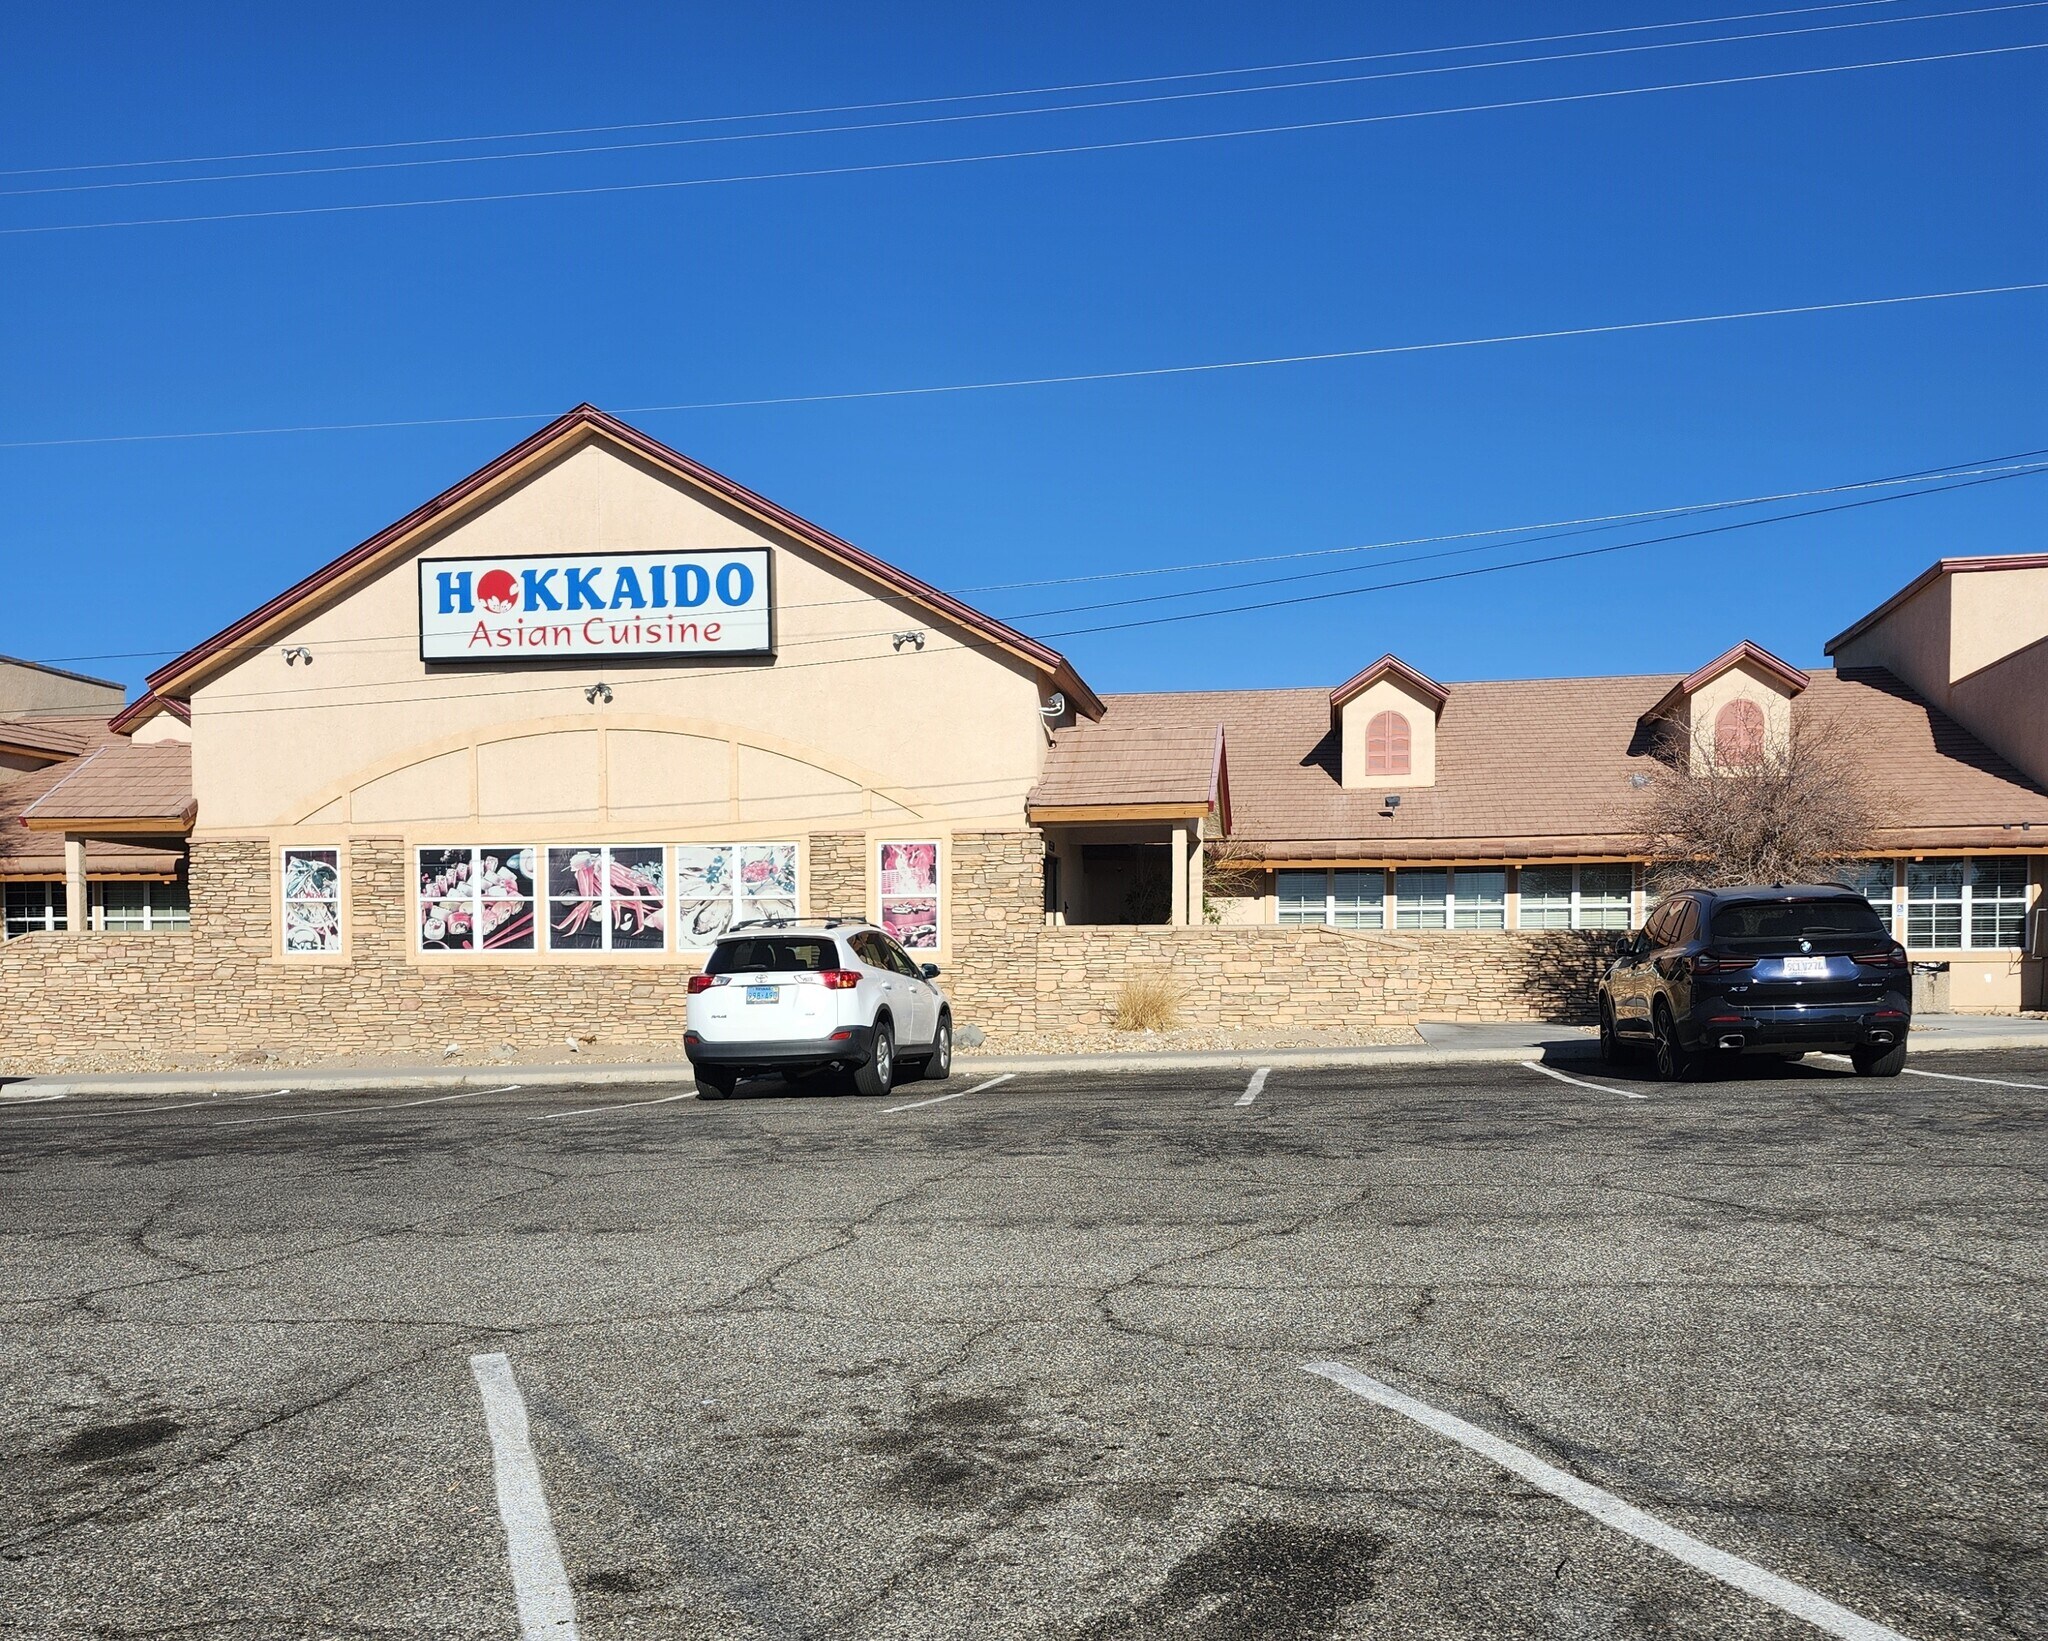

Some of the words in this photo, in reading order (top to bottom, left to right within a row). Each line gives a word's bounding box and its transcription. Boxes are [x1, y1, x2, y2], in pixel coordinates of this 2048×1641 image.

[436, 562, 754, 614] HOKKAIDO
[468, 618, 571, 649] Asian
[583, 615, 722, 645] Cuisine
